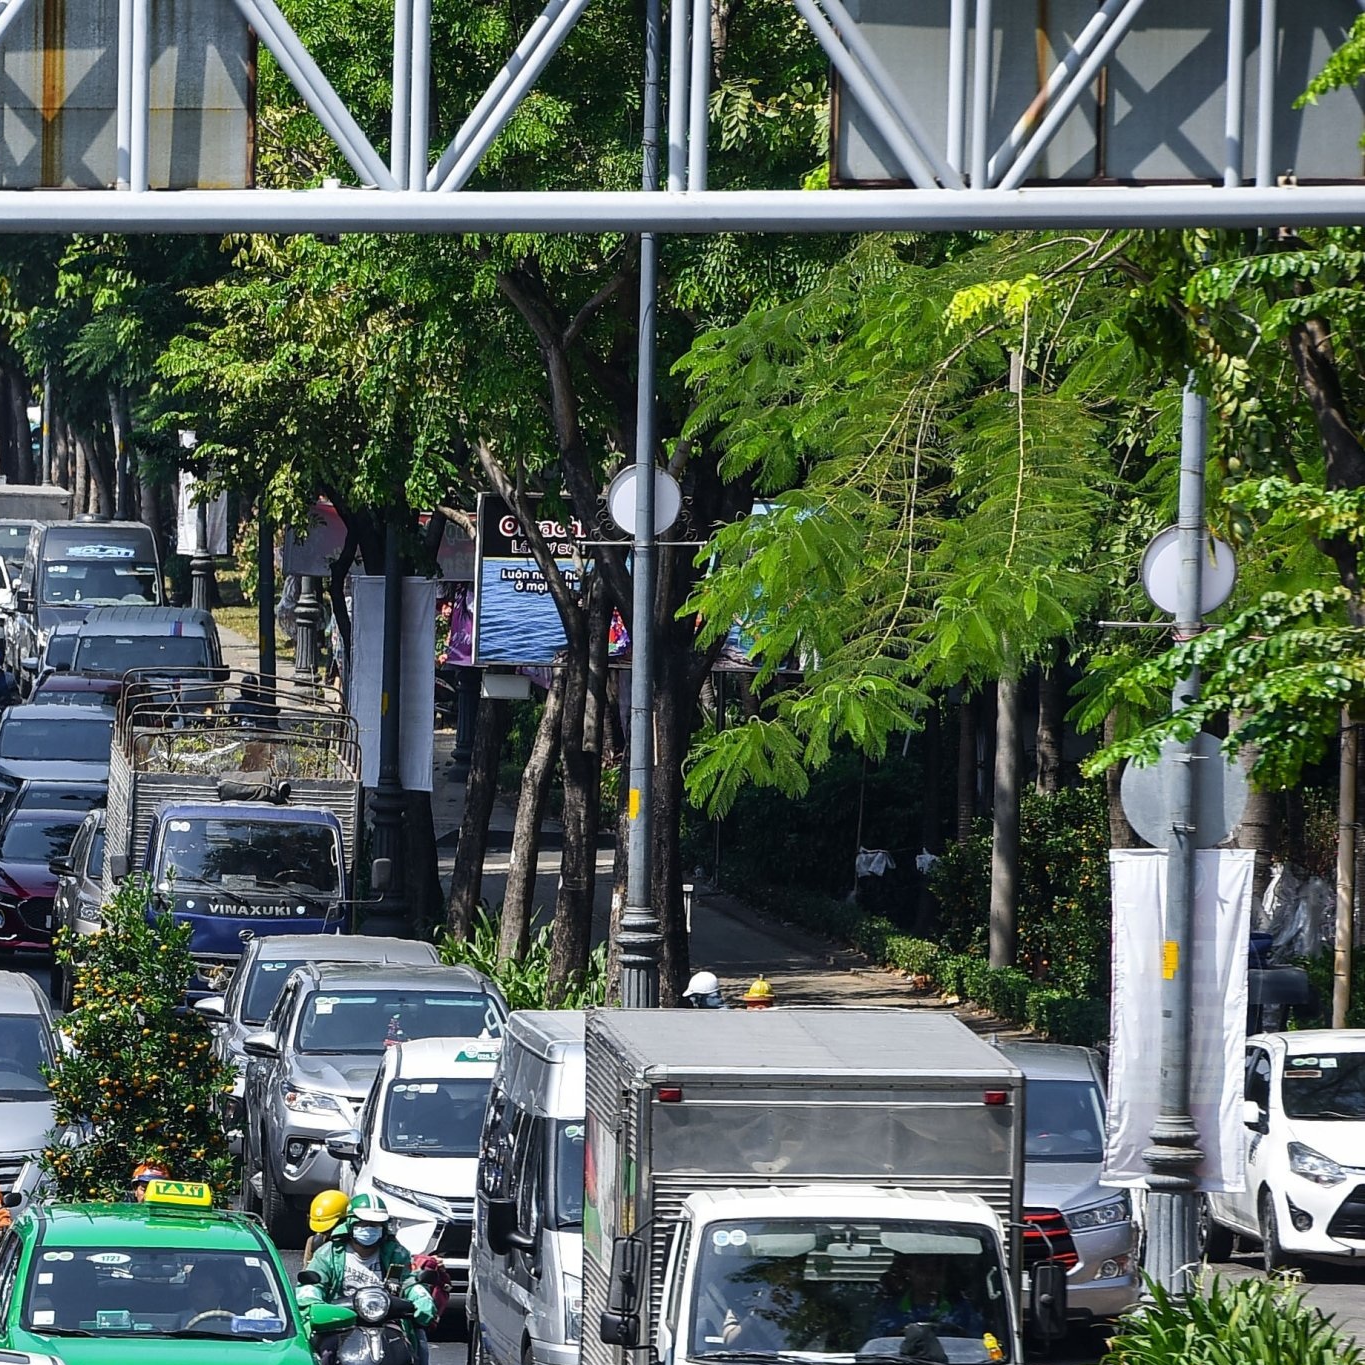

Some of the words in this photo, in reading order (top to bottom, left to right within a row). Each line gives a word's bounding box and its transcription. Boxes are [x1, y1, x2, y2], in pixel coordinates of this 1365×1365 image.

[501, 569, 530, 580] Luôn
[526, 584, 548, 594] mọi
[209, 902, 291, 916] VINAXUKI
[155, 1182, 204, 1198] TAXI
